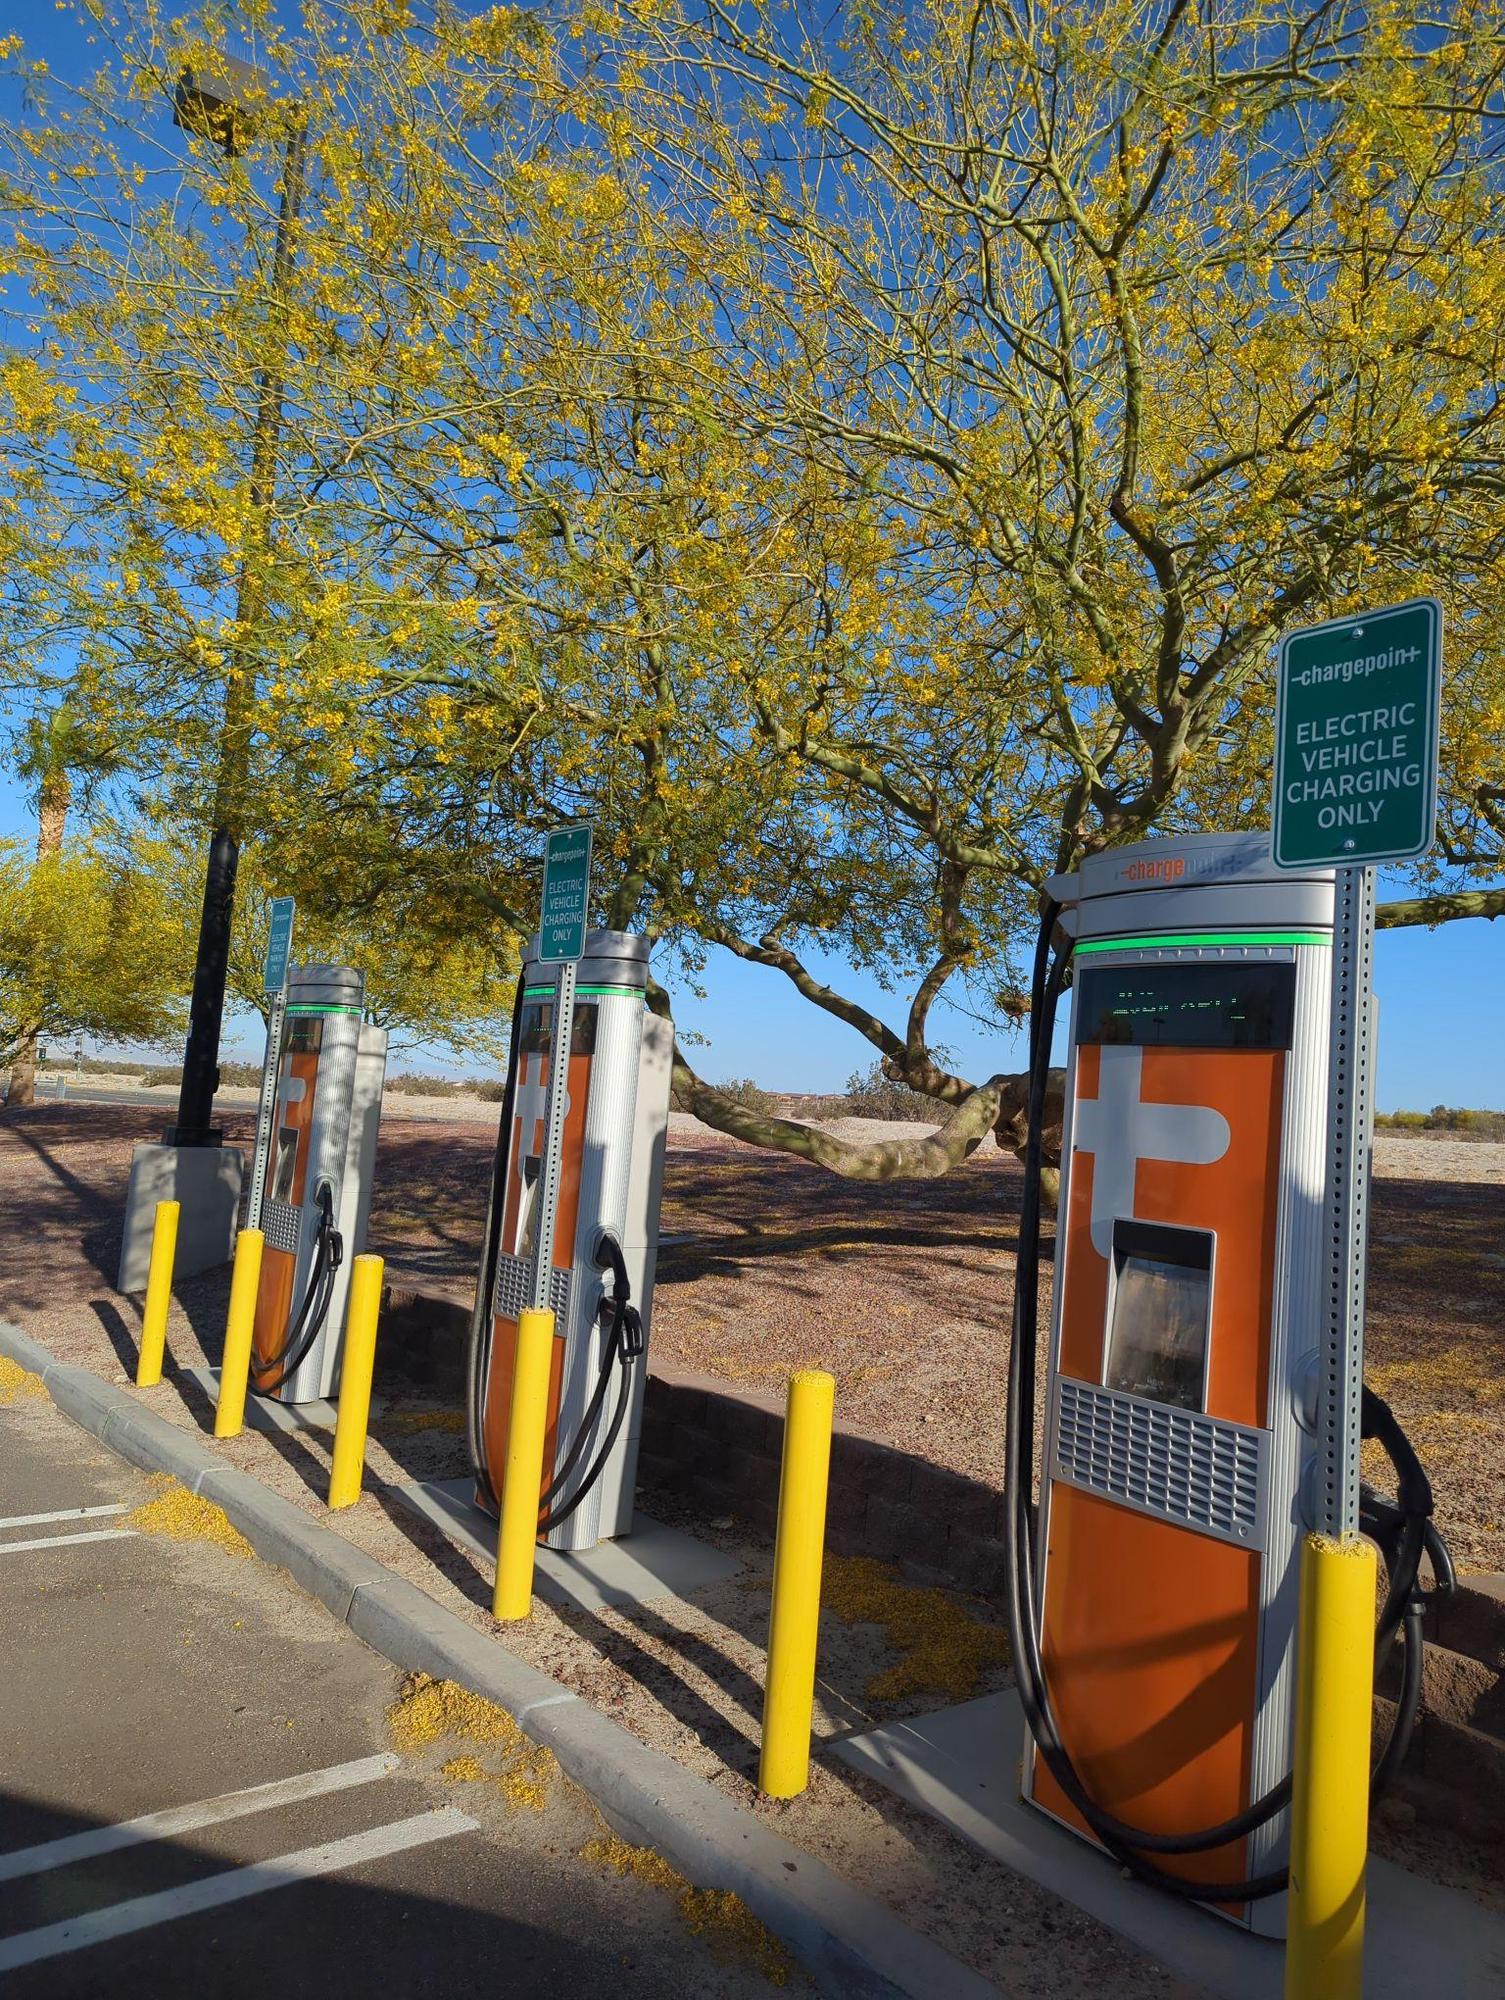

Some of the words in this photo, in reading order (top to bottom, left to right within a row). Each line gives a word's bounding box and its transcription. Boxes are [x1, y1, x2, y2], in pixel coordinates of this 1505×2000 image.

[1292, 646, 1421, 686] chargepoint
[1296, 702, 1416, 745] ELECTRIC
[1301, 735, 1408, 772] VEHICLE
[1286, 763, 1421, 804] CHARGING
[1317, 799, 1385, 829] ONLY
[548, 878, 583, 894] ELECTRIC
[549, 895, 580, 910] VEHICLE
[544, 911, 582, 926] CHARGING
[552, 928, 572, 942] ONLY
